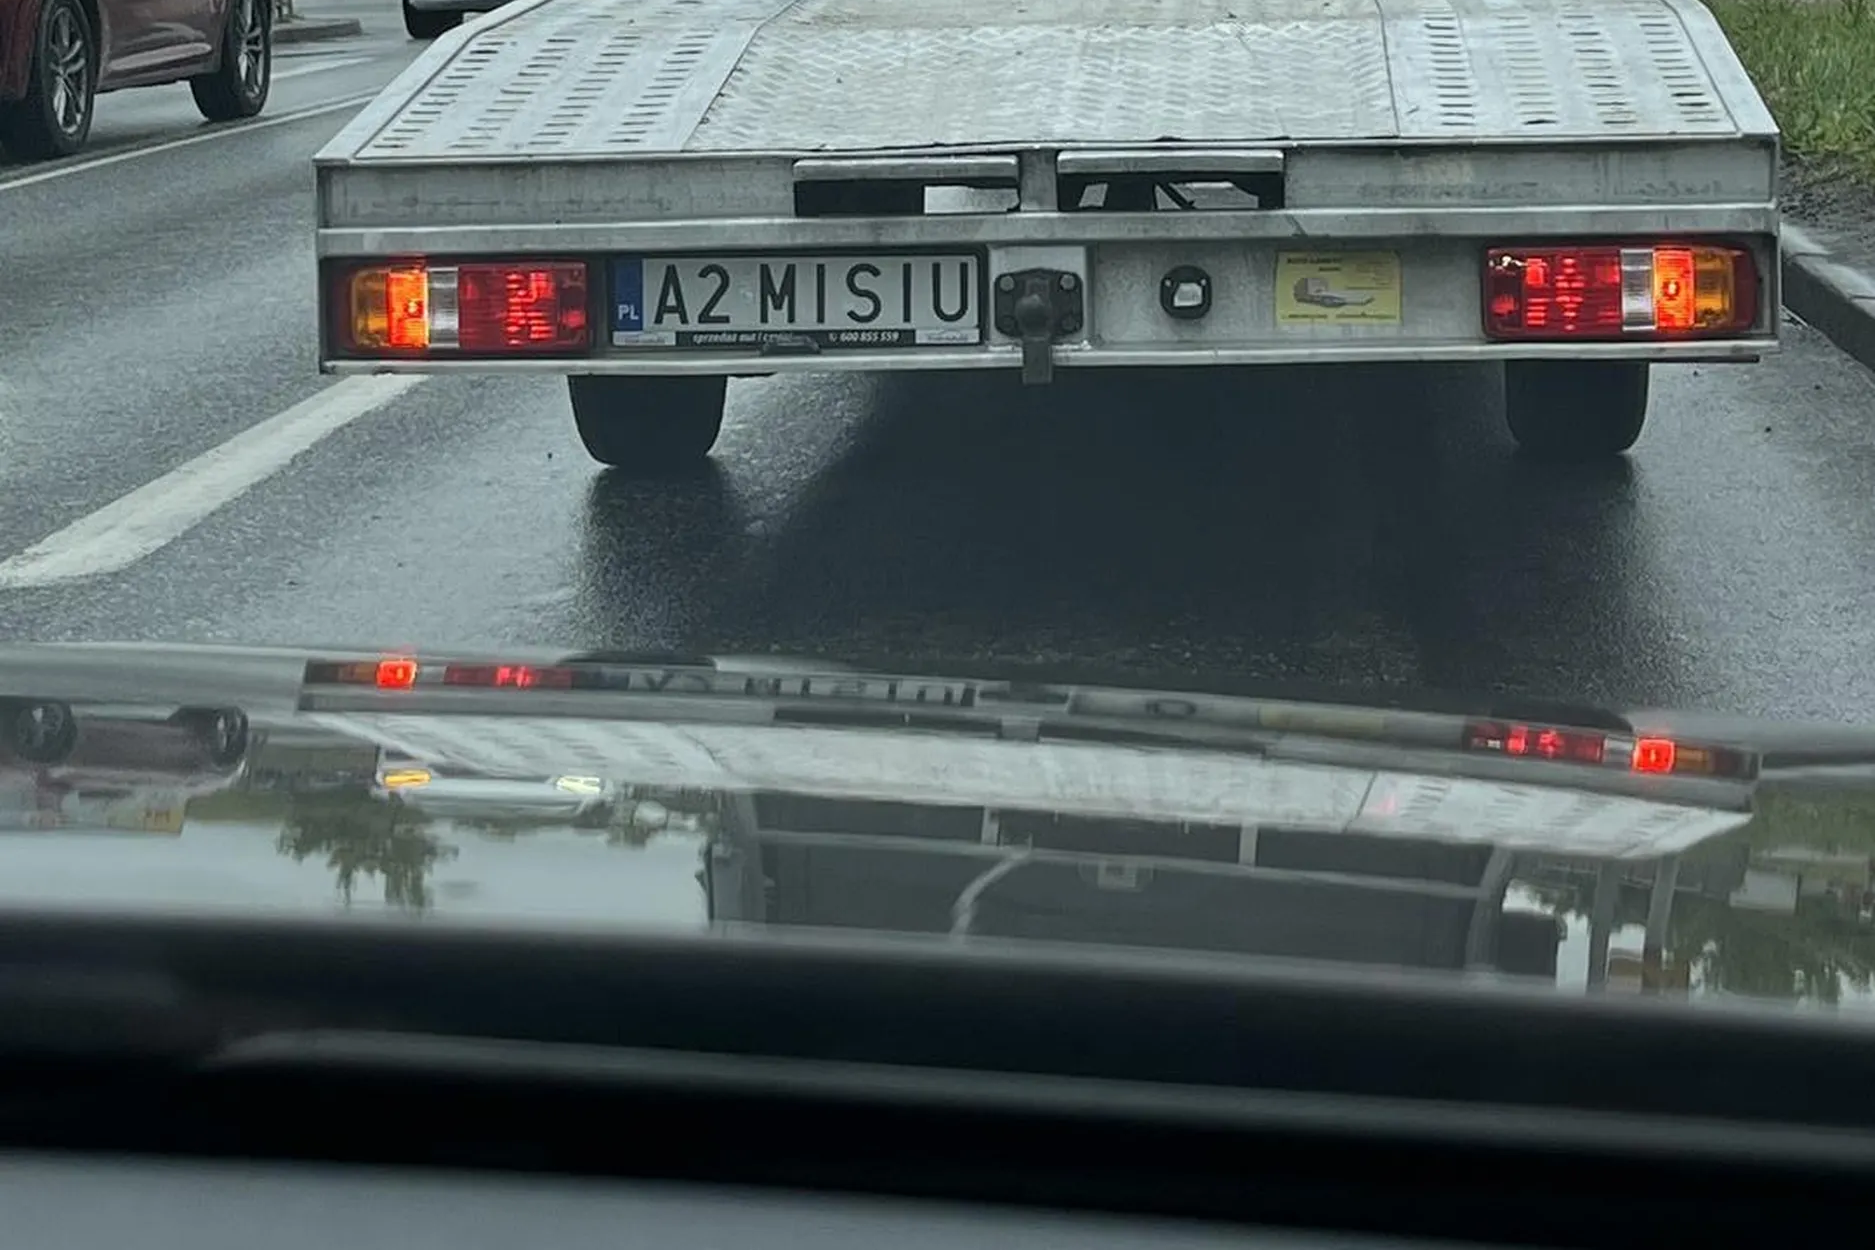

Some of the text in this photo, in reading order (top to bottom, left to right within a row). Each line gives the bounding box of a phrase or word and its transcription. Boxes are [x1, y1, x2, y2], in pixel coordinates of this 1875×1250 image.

[617, 303, 640, 321] PL
[653, 261, 969, 325] A2 MISIU
